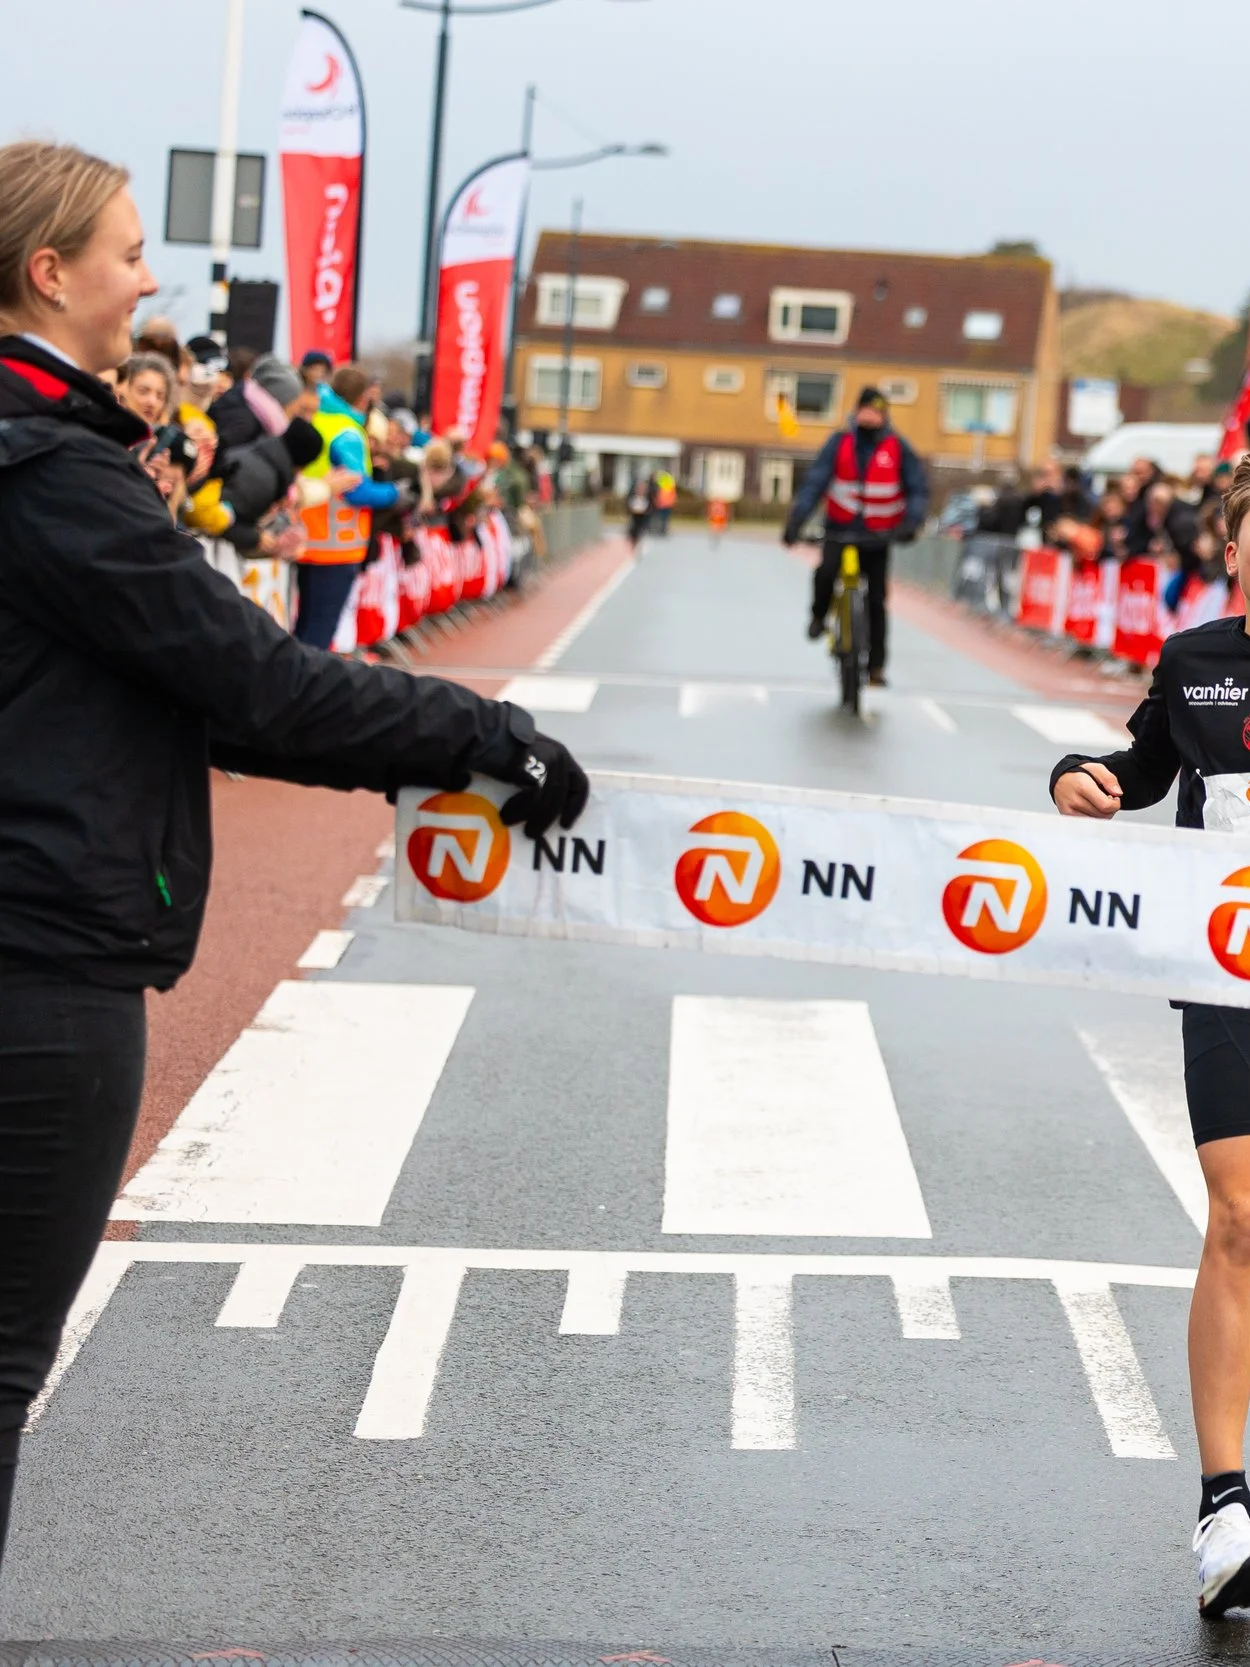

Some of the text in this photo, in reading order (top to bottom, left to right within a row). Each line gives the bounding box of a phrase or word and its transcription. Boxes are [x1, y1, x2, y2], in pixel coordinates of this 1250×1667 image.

[1183, 677, 1249, 701] vanhier
[533, 837, 606, 875] NN
[802, 860, 875, 901] NN
[1069, 887, 1140, 930] NN
